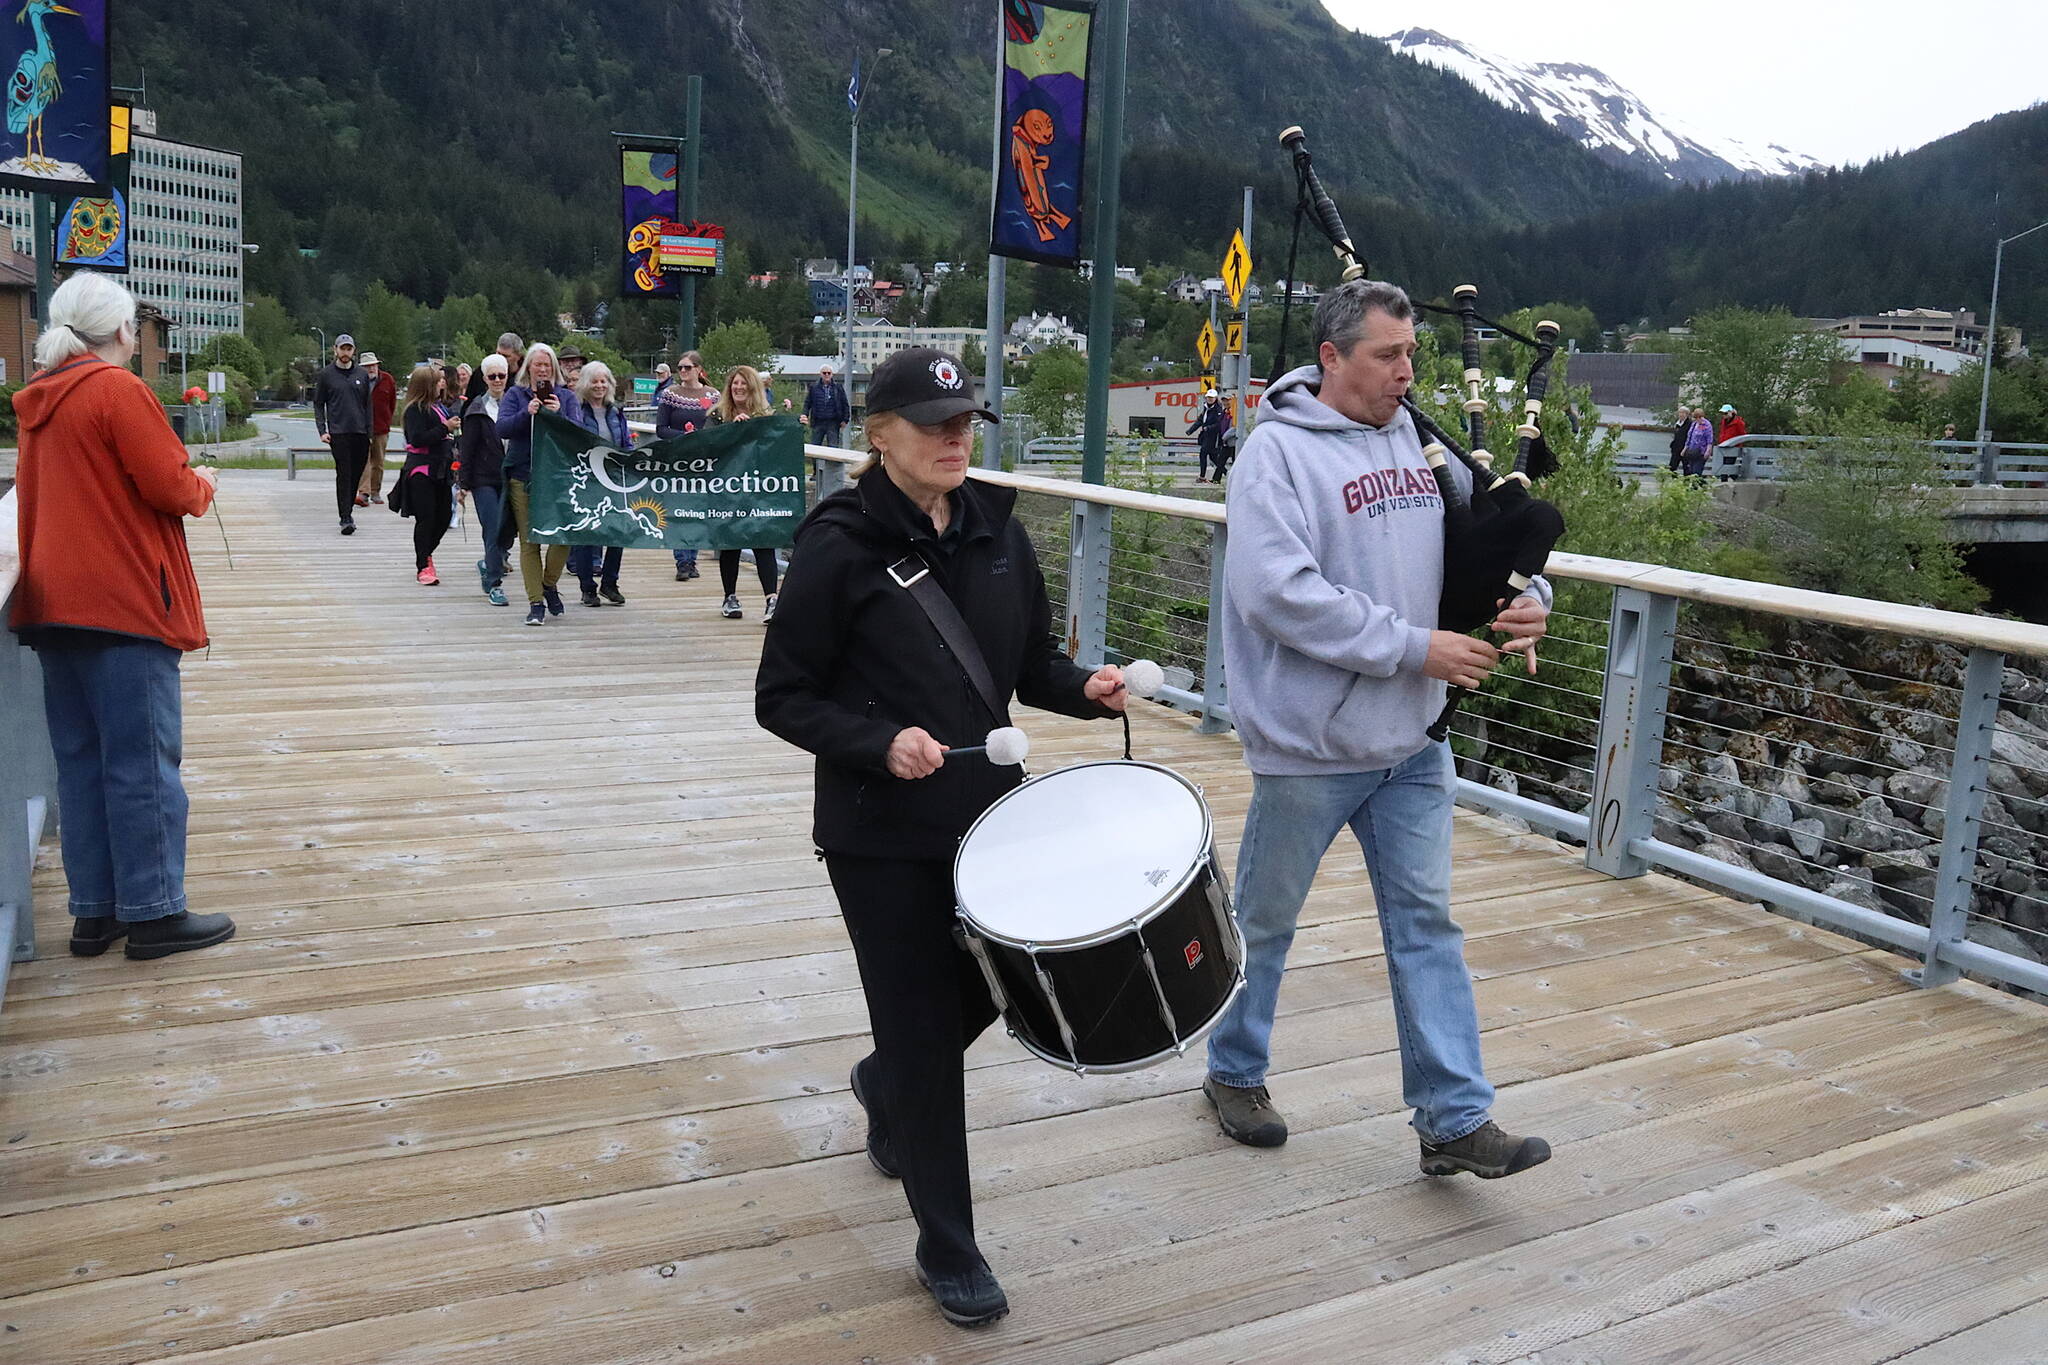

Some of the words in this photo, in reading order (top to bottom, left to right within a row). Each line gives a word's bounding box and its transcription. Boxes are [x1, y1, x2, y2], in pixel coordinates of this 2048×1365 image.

[1342, 468, 1440, 515] GONZAG
[674, 508, 705, 519] Giving
[708, 508, 733, 519] Hope
[736, 509, 746, 518] to
[749, 508, 793, 518] Alaskans
